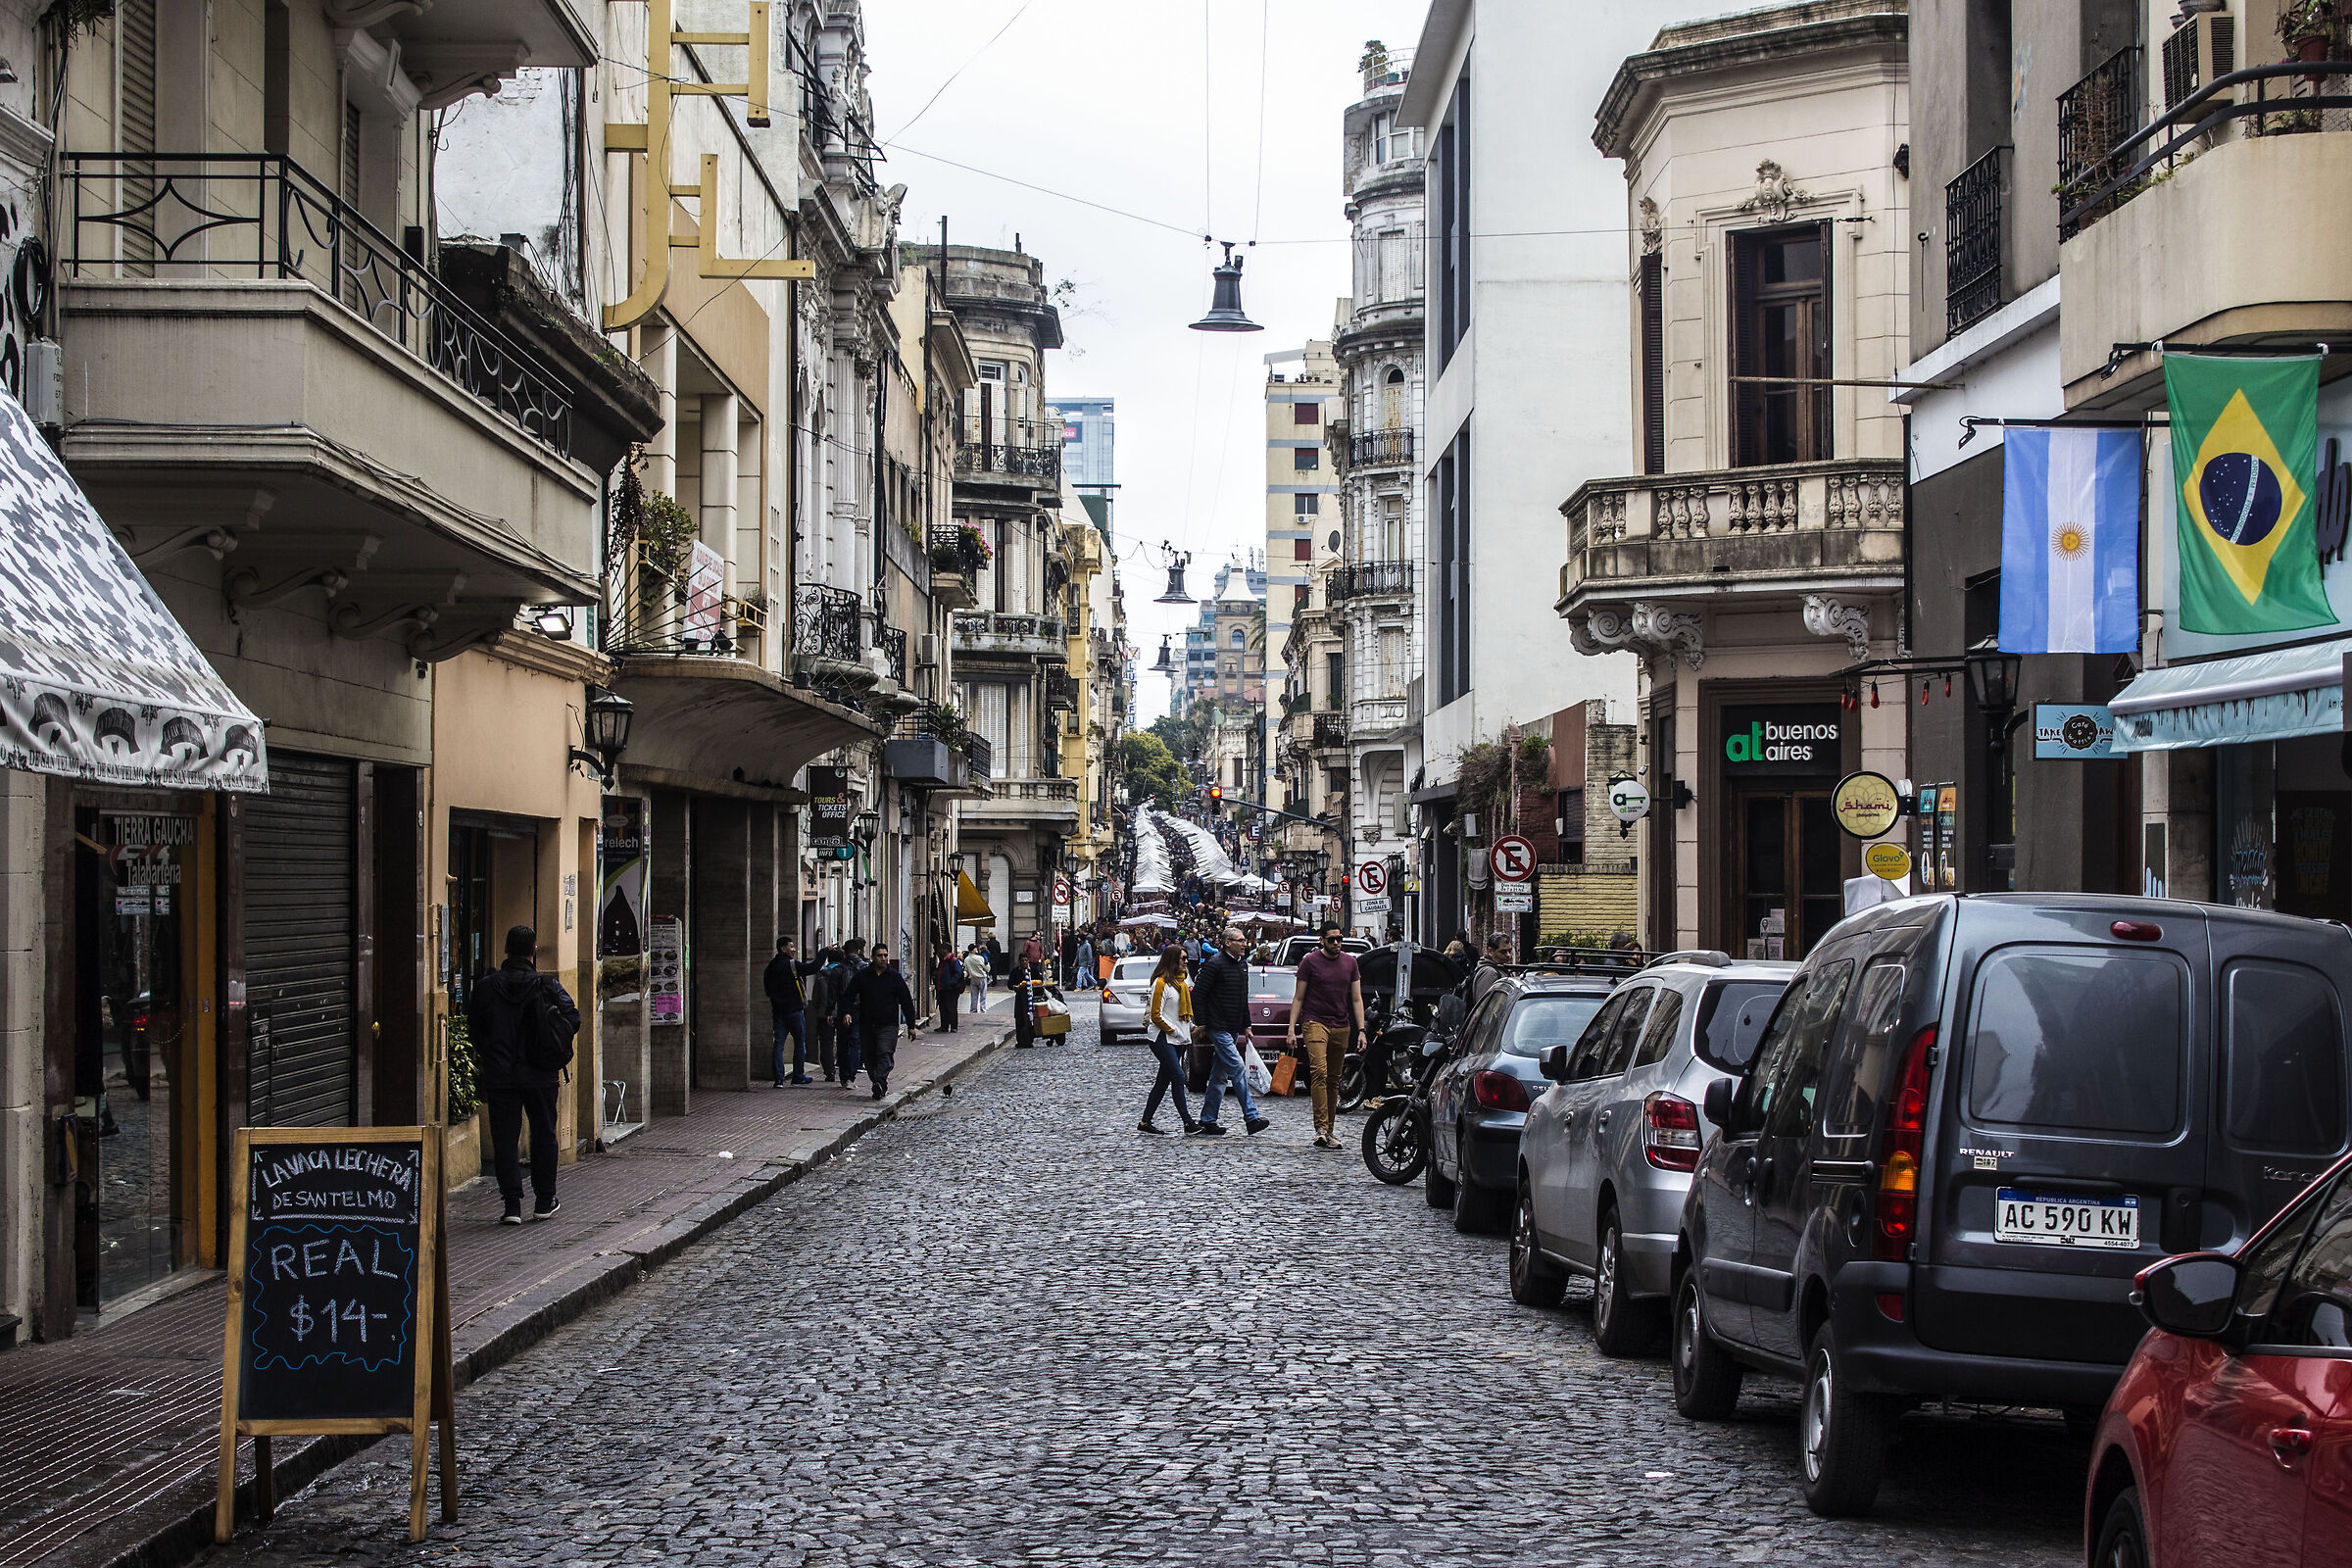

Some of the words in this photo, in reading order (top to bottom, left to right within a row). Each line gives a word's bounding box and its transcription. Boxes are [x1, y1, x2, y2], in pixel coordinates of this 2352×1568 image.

[1766, 721, 1838, 740] buenos
[2038, 727, 2061, 737] TAKE
[1766, 742, 1813, 760] aires
[813, 796, 836, 805] TOURS
[836, 792, 846, 804] &
[114, 816, 151, 845] TIERRA
[153, 817, 194, 845] GAUCHA
[1873, 854, 1900, 862] Glovo
[1959, 1148, 2015, 1158] RENAULT
[334, 1148, 413, 1192] LECHERA
[271, 1191, 293, 1209] DE
[295, 1190, 328, 1208] SAN
[326, 1189, 397, 1209] TELMO
[2035, 1196, 2067, 1204] REPUBLICA
[2068, 1198, 2101, 1206] ARGENTINA
[2004, 1203, 2034, 1229] AC
[2044, 1205, 2091, 1233] 590
[2101, 1209, 2132, 1236] KW
[271, 1239, 399, 1281] REAL
